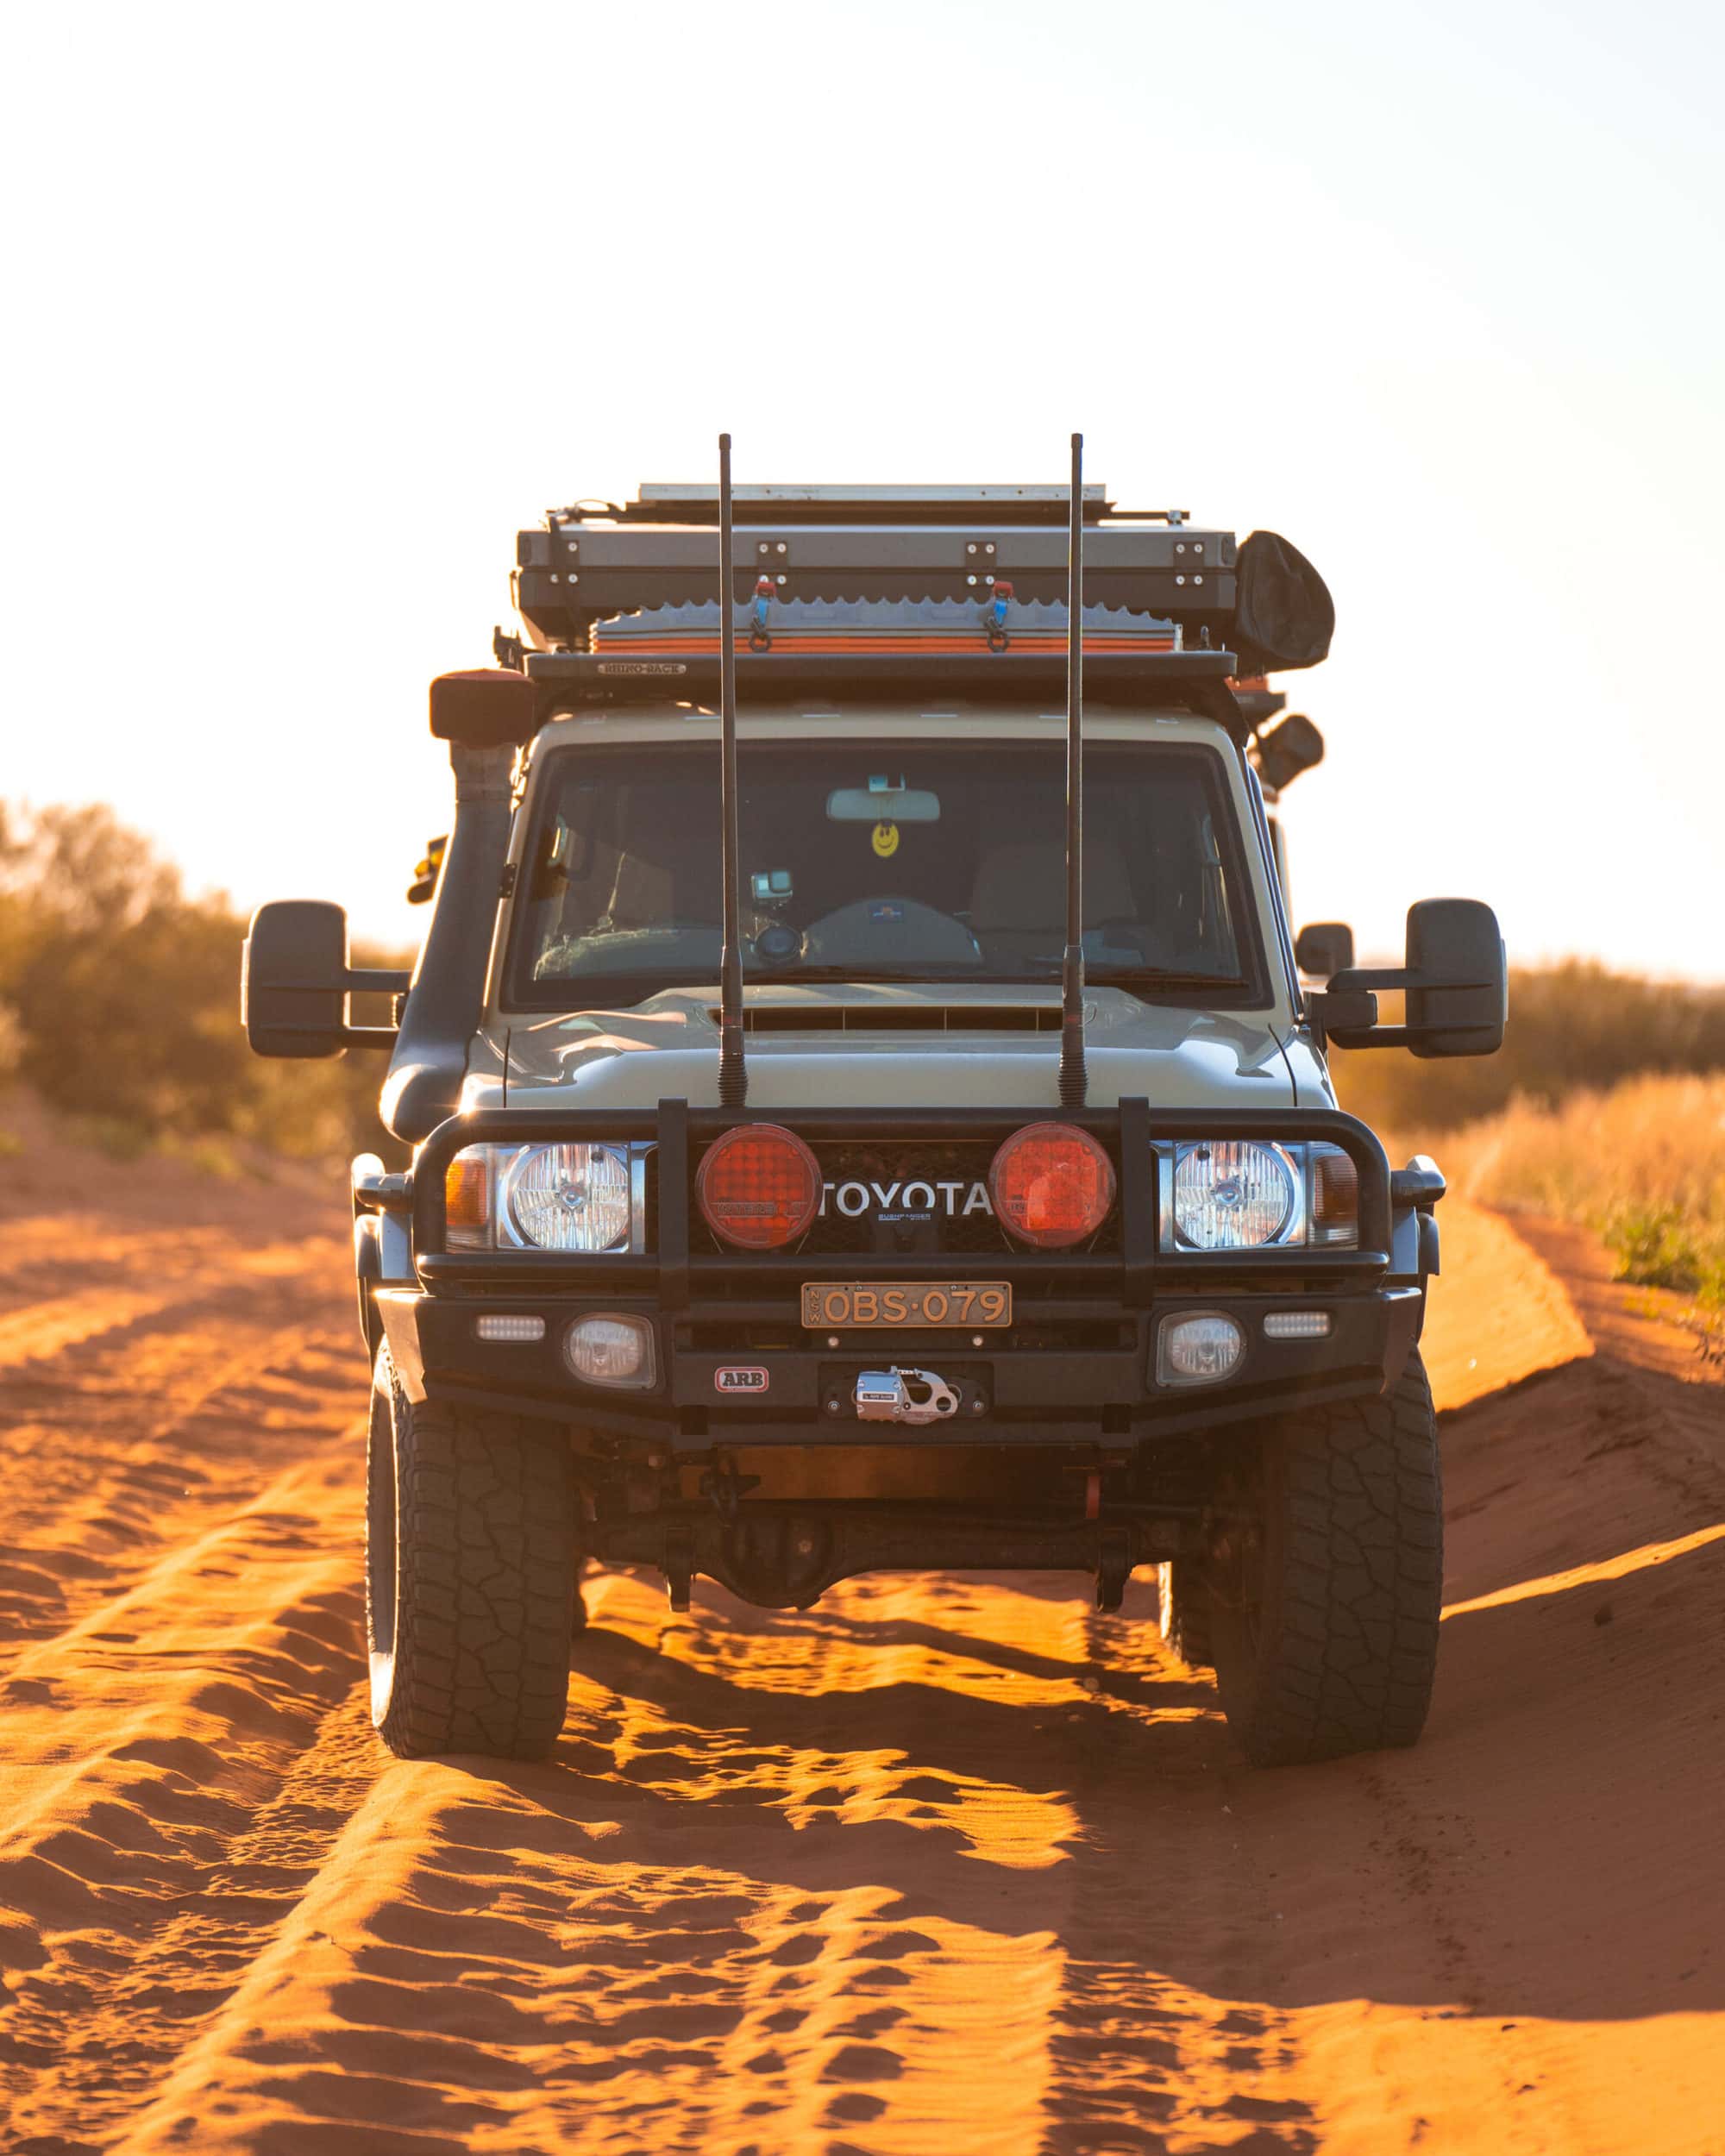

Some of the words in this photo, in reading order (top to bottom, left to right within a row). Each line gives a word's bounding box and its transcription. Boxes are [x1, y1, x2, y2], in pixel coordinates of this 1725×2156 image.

[818, 1181, 994, 1217] TOYOTA
[809, 1290, 820, 1321] NSW
[722, 1372, 763, 1386] ARB
